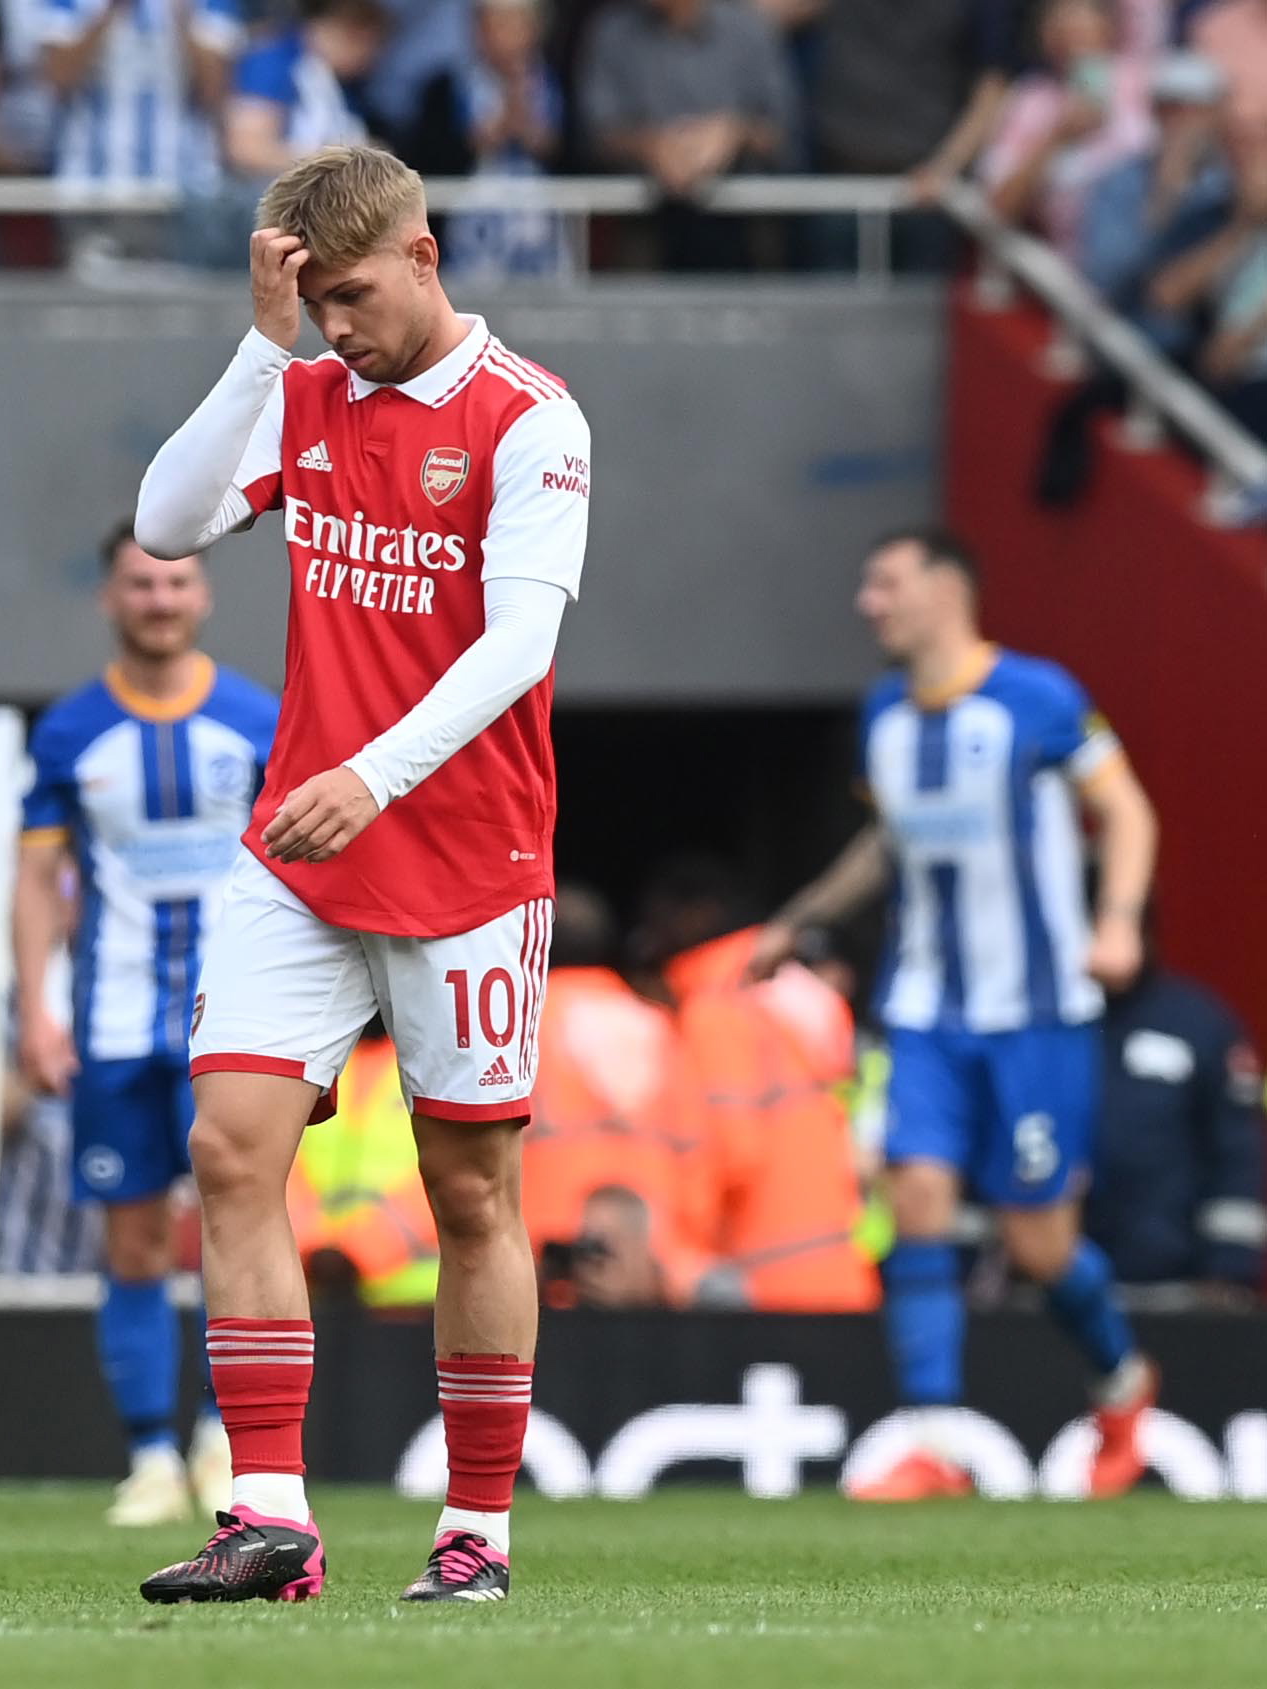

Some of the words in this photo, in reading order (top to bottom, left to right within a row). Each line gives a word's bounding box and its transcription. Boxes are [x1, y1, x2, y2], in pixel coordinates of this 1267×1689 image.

[429, 455, 463, 468] Arsenal
[284, 494, 466, 571] Emirates
[305, 558, 349, 600] FLY
[350, 567, 435, 615] BETTER
[444, 967, 515, 1049] 10
[478, 1073, 514, 1087] adidas
